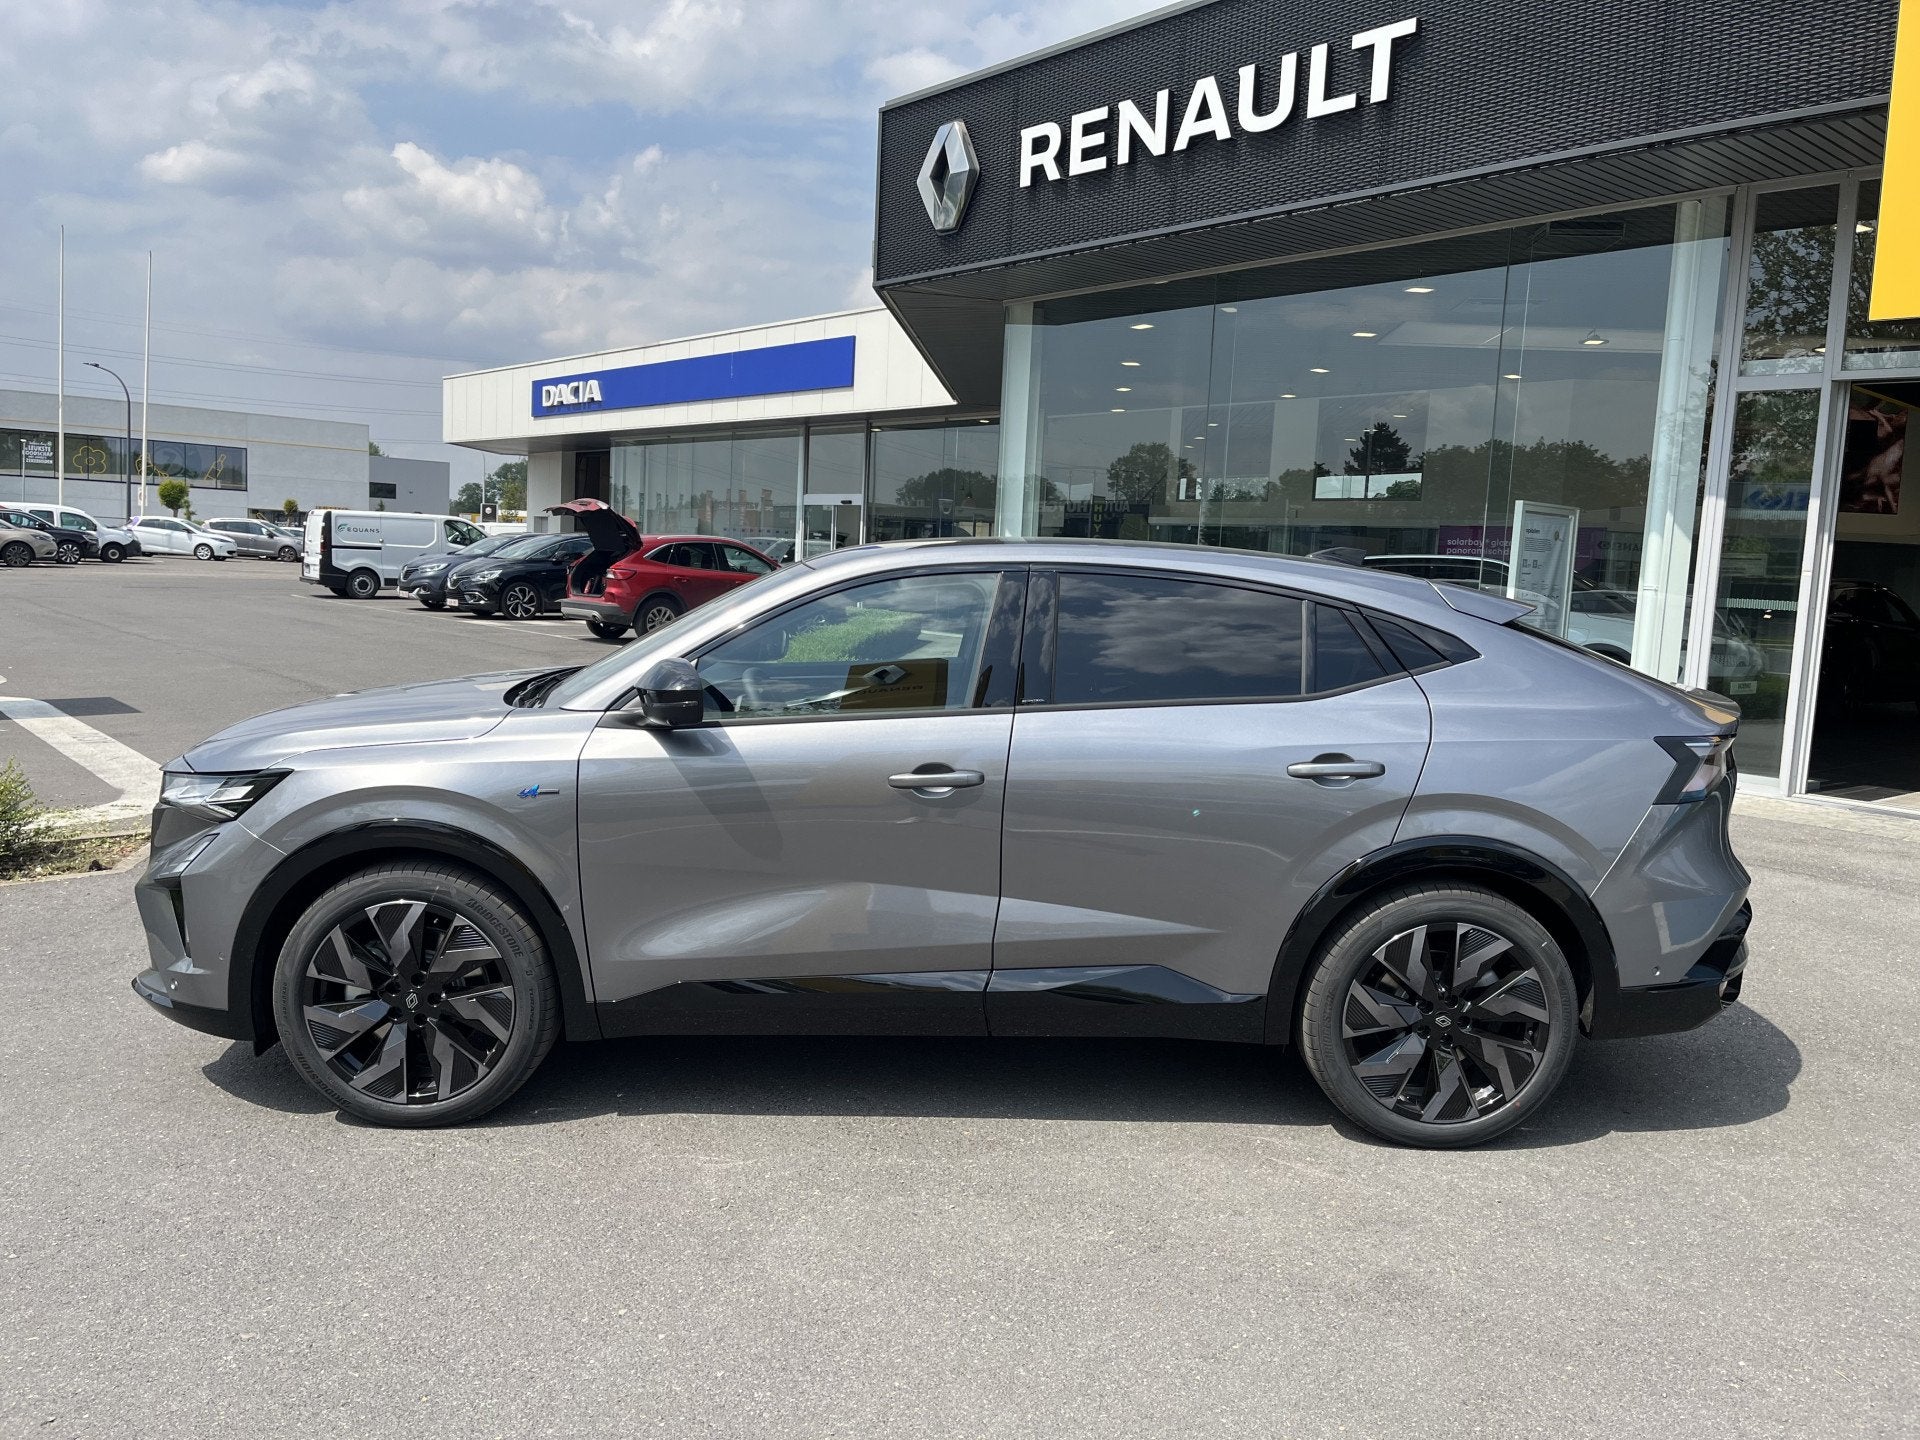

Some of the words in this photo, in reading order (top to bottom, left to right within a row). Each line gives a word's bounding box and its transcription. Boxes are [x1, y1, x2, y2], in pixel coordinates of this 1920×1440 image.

[1019, 17, 1418, 188] RENAULT
[542, 379, 602, 407] DACIA
[465, 897, 524, 958] BRIDGESTONE
